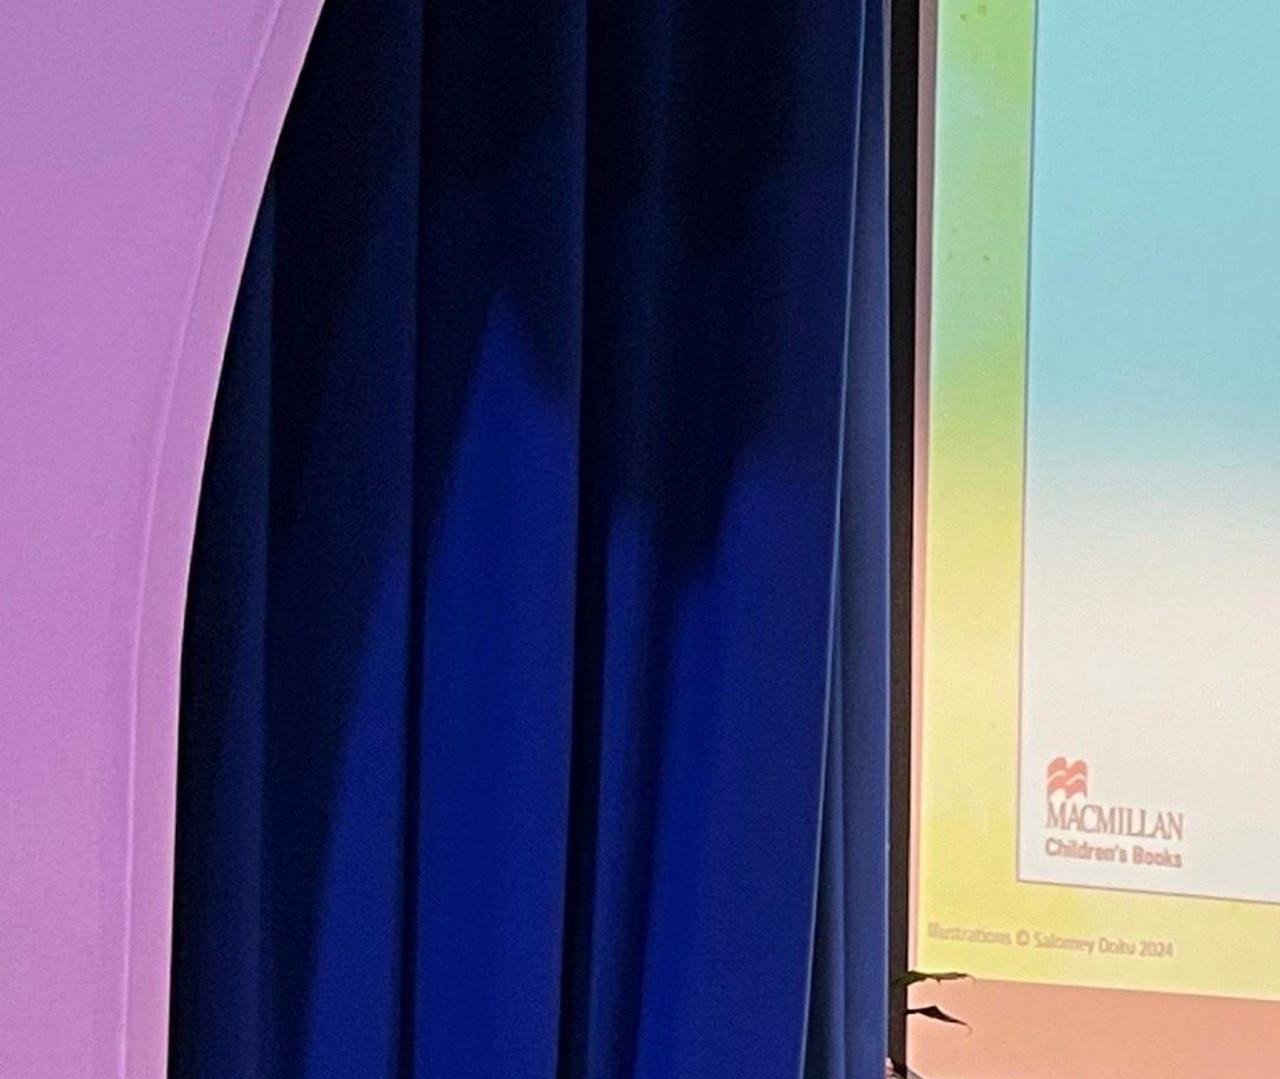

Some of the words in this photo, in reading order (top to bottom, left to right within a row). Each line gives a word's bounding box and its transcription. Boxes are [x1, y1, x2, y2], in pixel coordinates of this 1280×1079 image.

[1045, 800, 1184, 840] MACMILLAN
[1045, 837, 1128, 863] Children's
[1132, 844, 1183, 868] Books
[927, 921, 1012, 946] Illustrations
[1034, 931, 1095, 954] Salomey
[1098, 936, 1136, 955] Doku
[1139, 940, 1174, 958] 2024
